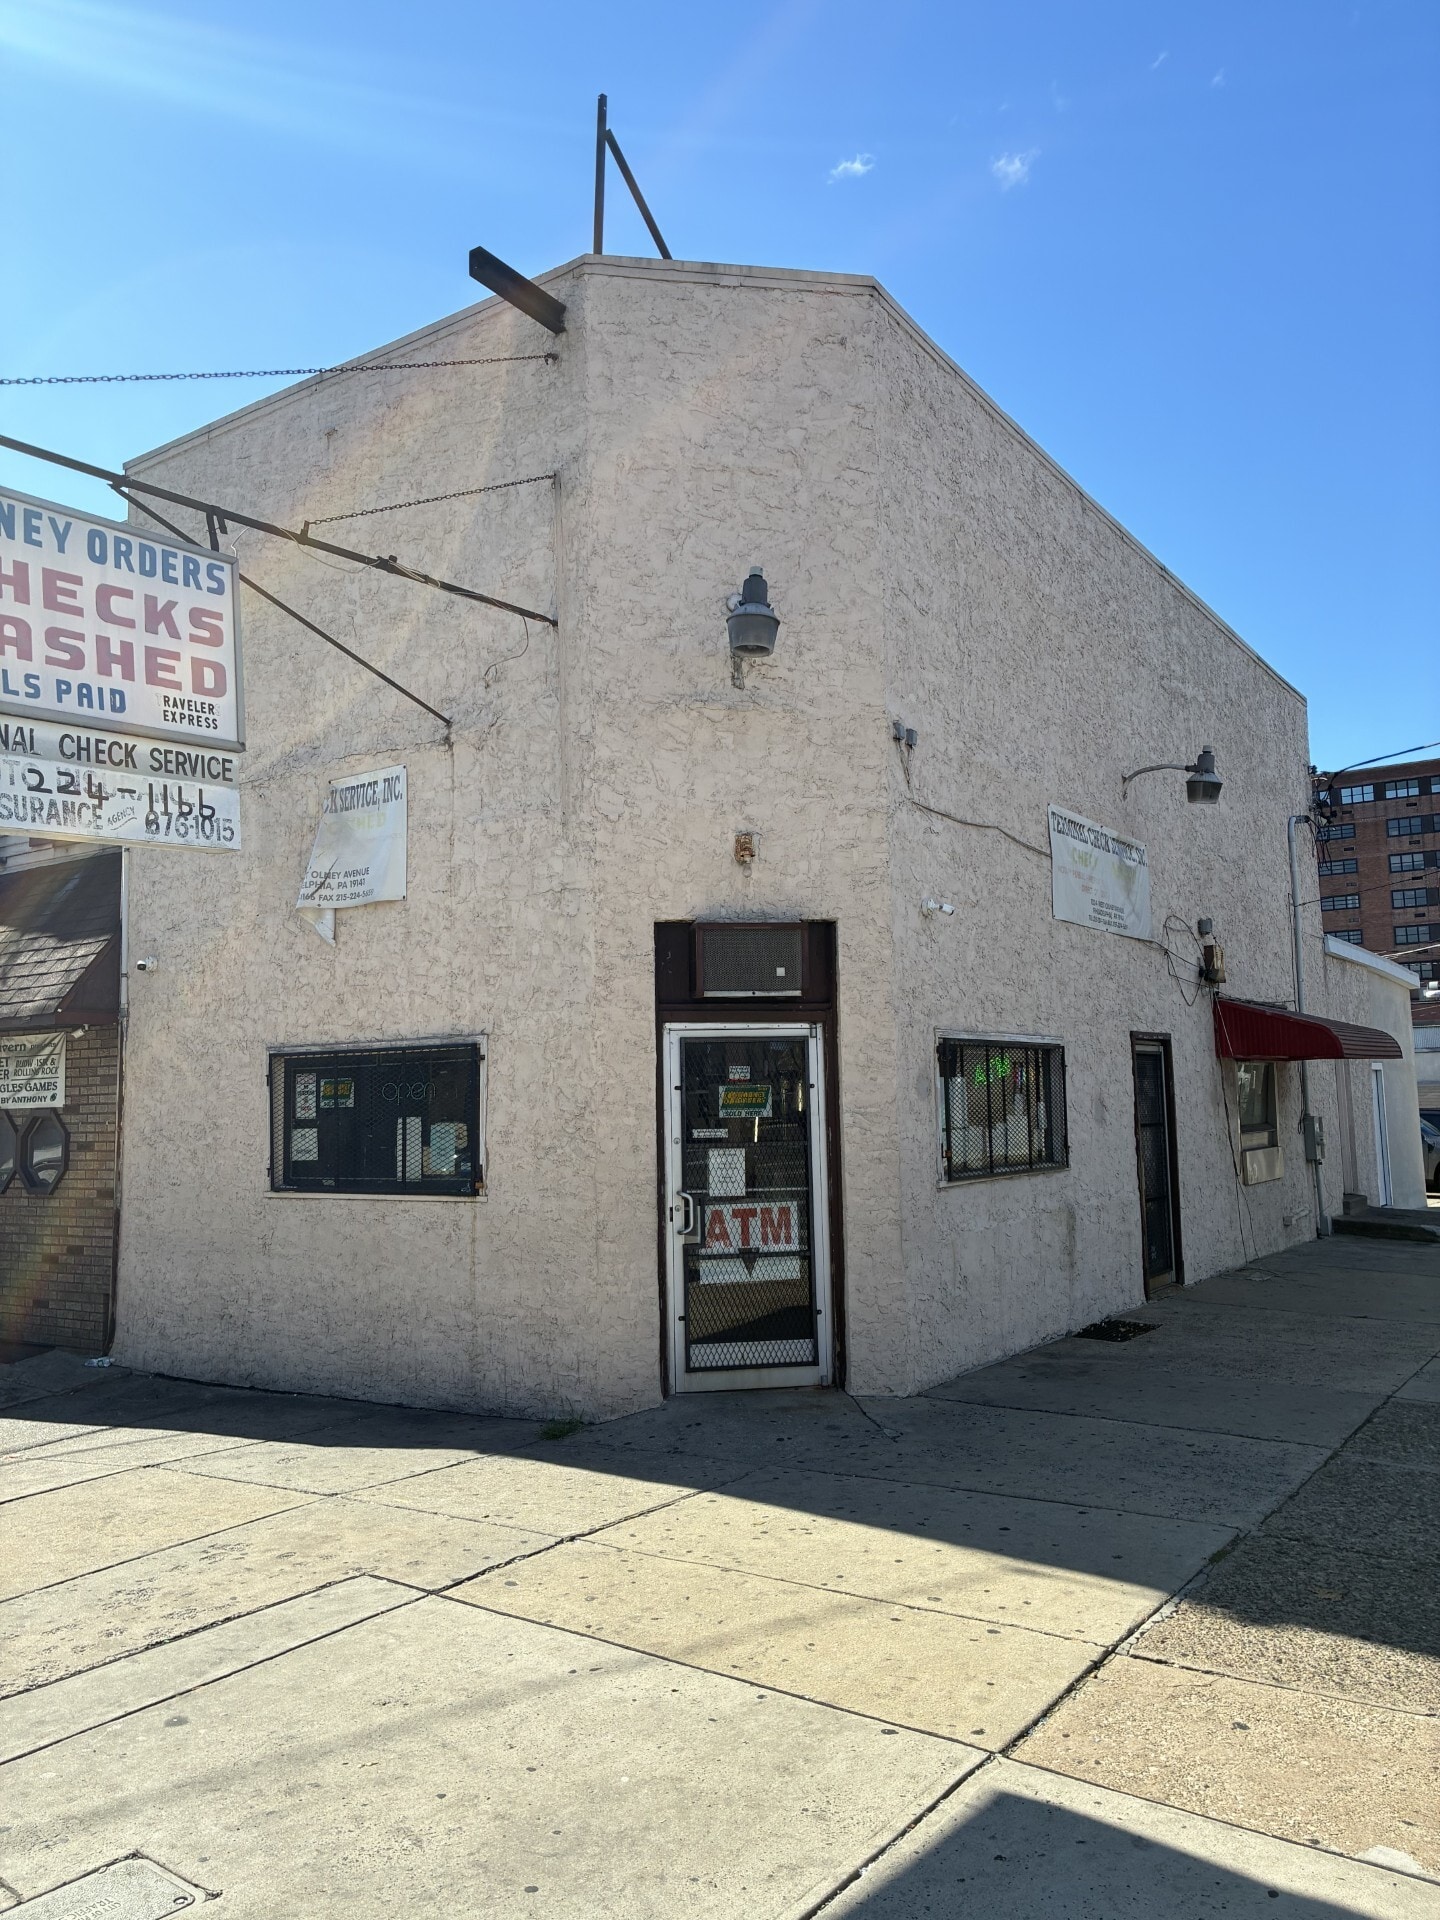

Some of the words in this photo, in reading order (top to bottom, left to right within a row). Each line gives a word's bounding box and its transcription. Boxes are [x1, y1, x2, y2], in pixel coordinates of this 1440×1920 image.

[87, 528, 225, 597] ORDERS
[56, 679, 126, 713] PAID
[163, 709, 219, 730] EXPRESS
[59, 733, 137, 768] CHECK
[149, 747, 235, 783] SERVICE
[340, 780, 380, 812] SERVICE,
[382, 775, 403, 803] INC.
[311, 871, 342, 880] OLNEY
[343, 867, 370, 879] AVENUE
[337, 881, 348, 890] PA
[318, 893, 334, 902] FAX
[0, 1043, 26, 1052] vern
[41, 1066, 59, 1075] ROCK
[25, 1081, 57, 1092] GAMES
[1, 1096, 10, 1104] BY
[12, 1095, 47, 1103] ANTHONY
[705, 1206, 792, 1249] ATM
